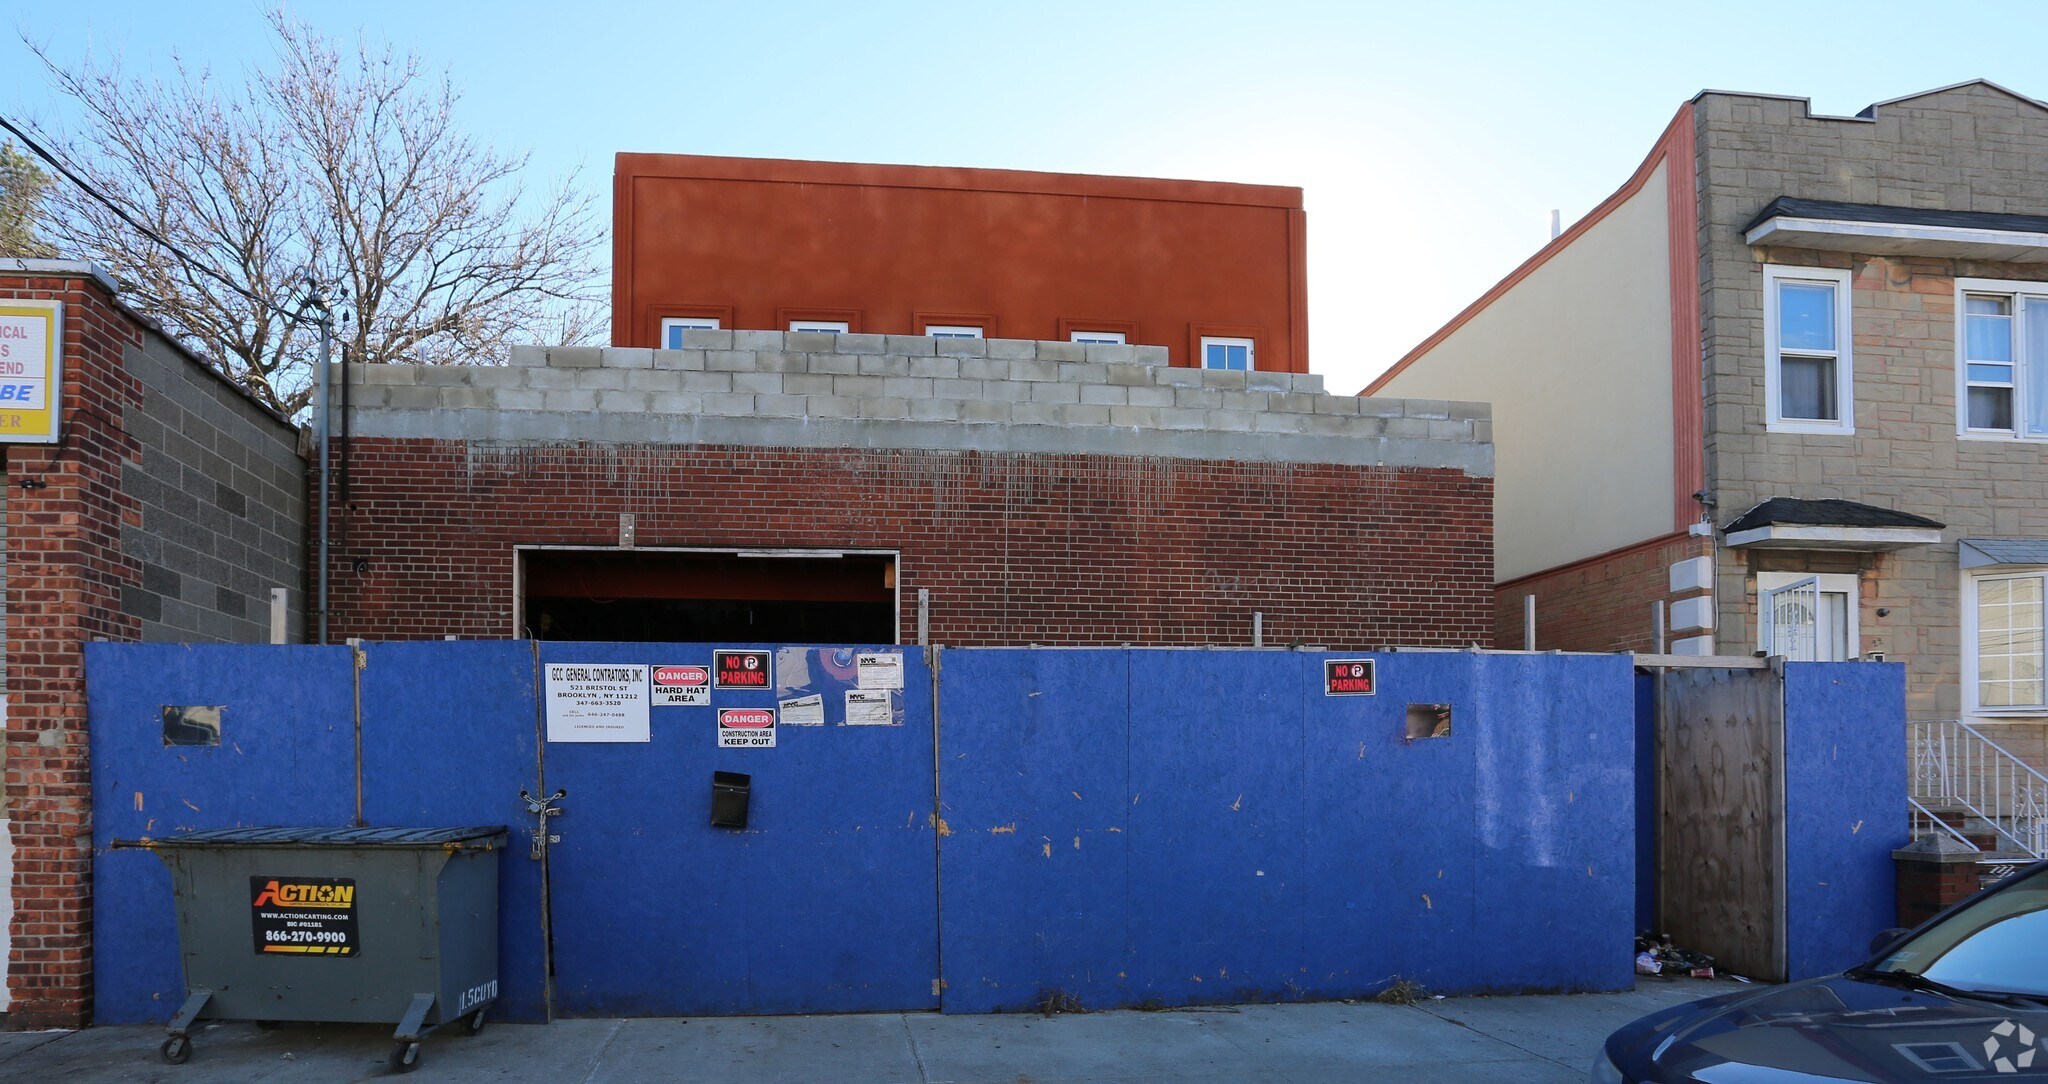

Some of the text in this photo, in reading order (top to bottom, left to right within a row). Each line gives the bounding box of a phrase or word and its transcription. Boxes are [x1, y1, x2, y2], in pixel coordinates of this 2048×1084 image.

[726, 656, 740, 669] NO
[552, 667, 563, 681] GCC
[566, 667, 592, 682] GENERAL
[632, 669, 642, 682] INC
[658, 671, 703, 681] DANGER
[720, 671, 765, 684] PARKING
[1335, 665, 1348, 677] NO
[1331, 678, 1370, 692] PARKING
[725, 715, 769, 723] DANGER
[253, 880, 354, 907] ACTION
[260, 912, 349, 920] WWW.ACTIONCARTING.COM
[265, 930, 346, 943] 866-270-9900
